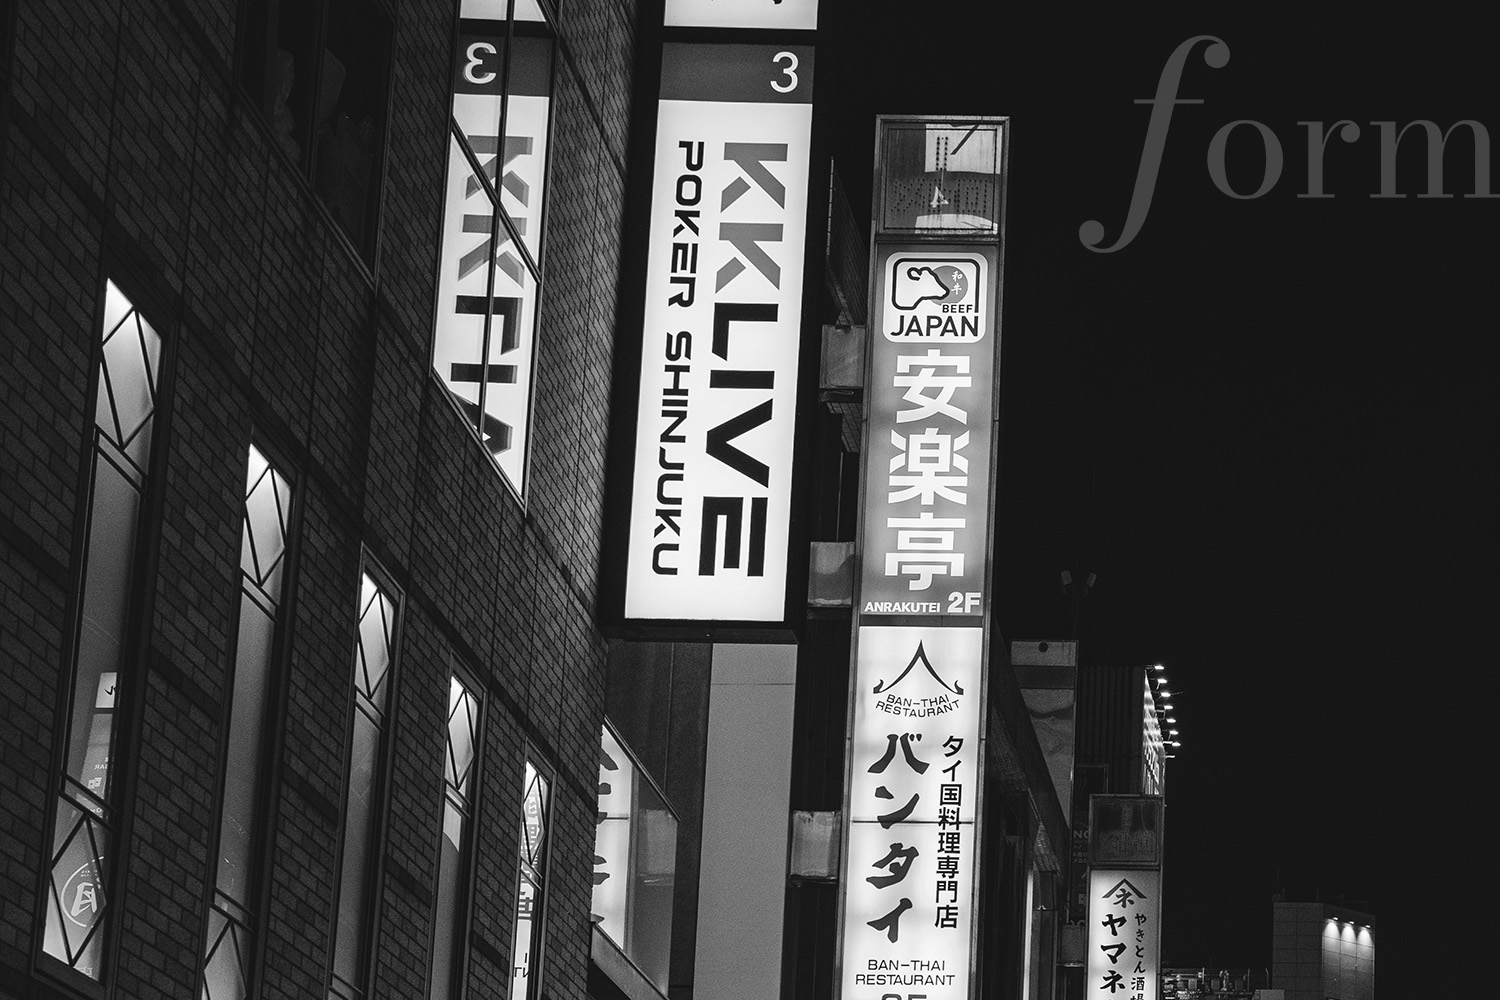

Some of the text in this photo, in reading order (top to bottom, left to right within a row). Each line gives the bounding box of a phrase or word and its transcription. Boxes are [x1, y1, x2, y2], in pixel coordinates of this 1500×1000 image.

[770, 53, 799, 93] 3
[950, 270, 964, 296] 和牛
[941, 303, 974, 313] BEEF
[891, 315, 978, 337] JAPAN
[652, 141, 704, 576] POKER SHINJUKU
[698, 142, 788, 577] KKLIVE
[885, 350, 972, 591] 安楽亭
[864, 592, 981, 613] ANRAKUTEI 2F
[876, 699, 961, 718] RESTAURANT
[886, 692, 950, 709] BAN-THAI
[866, 733, 930, 943] バンタイ
[934, 736, 964, 929] タイ国料理専門店
[868, 960, 946, 971] BAN-THAI
[855, 974, 955, 986] RESTAURANT
